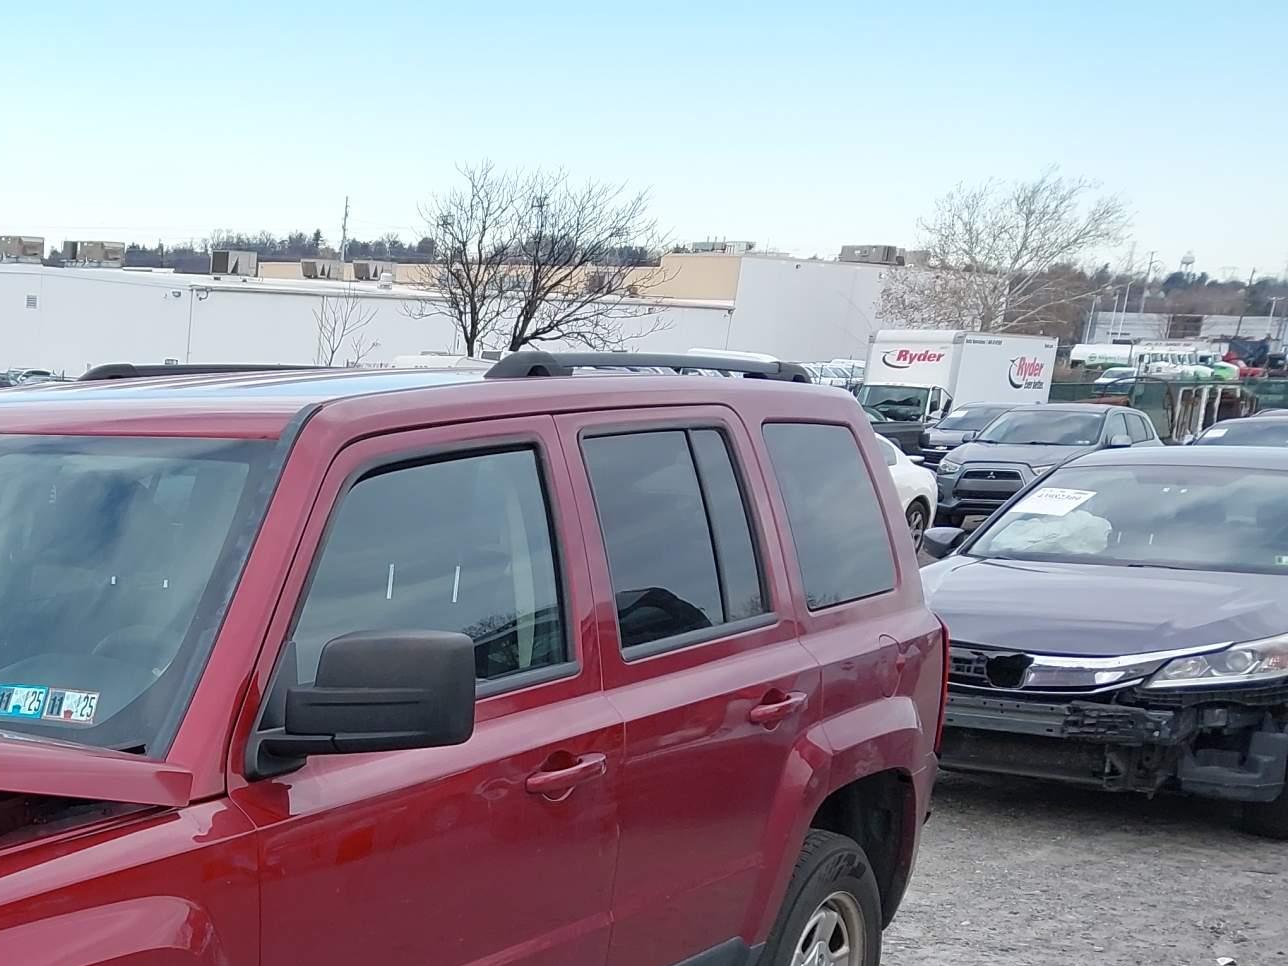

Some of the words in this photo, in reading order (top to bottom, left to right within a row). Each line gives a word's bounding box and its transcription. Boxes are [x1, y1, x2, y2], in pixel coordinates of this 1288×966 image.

[896, 349, 945, 365] Ryder
[1016, 357, 1044, 381] Ryder
[28, 690, 44, 711] 25
[49, 695, 64, 716] 11
[79, 694, 96, 717] 25
